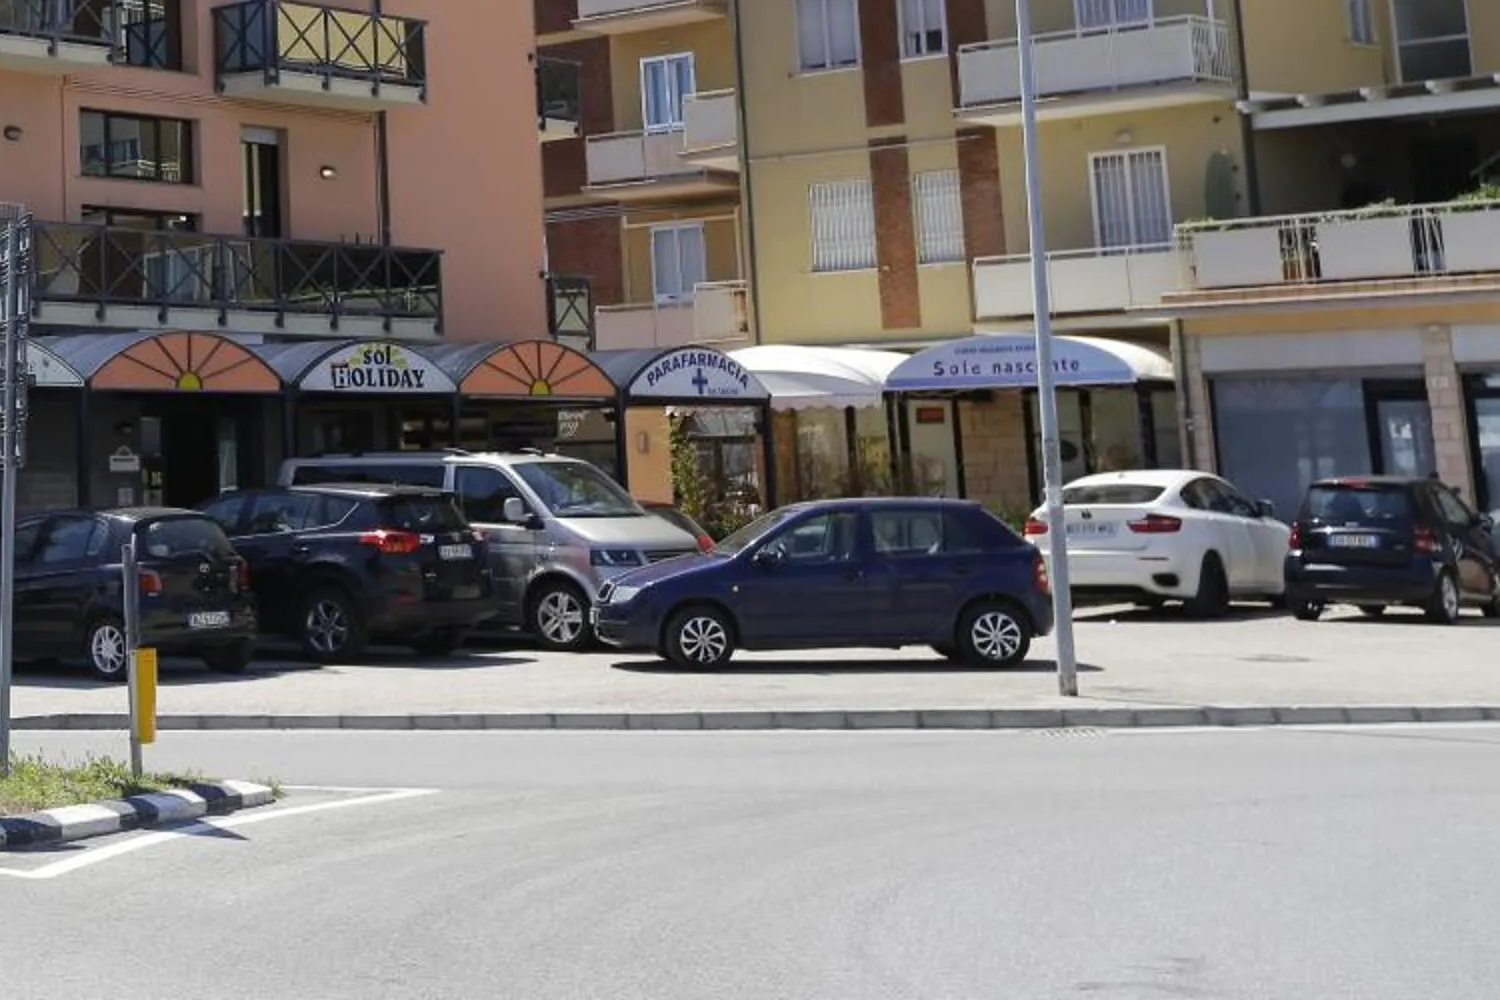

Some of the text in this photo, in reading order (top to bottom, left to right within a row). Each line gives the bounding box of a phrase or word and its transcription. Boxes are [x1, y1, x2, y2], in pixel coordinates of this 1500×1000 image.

[331, 363, 425, 388] HOLIDAY
[647, 352, 749, 390] PARAFARMACIA
[933, 358, 1079, 376] Sole nascnte
